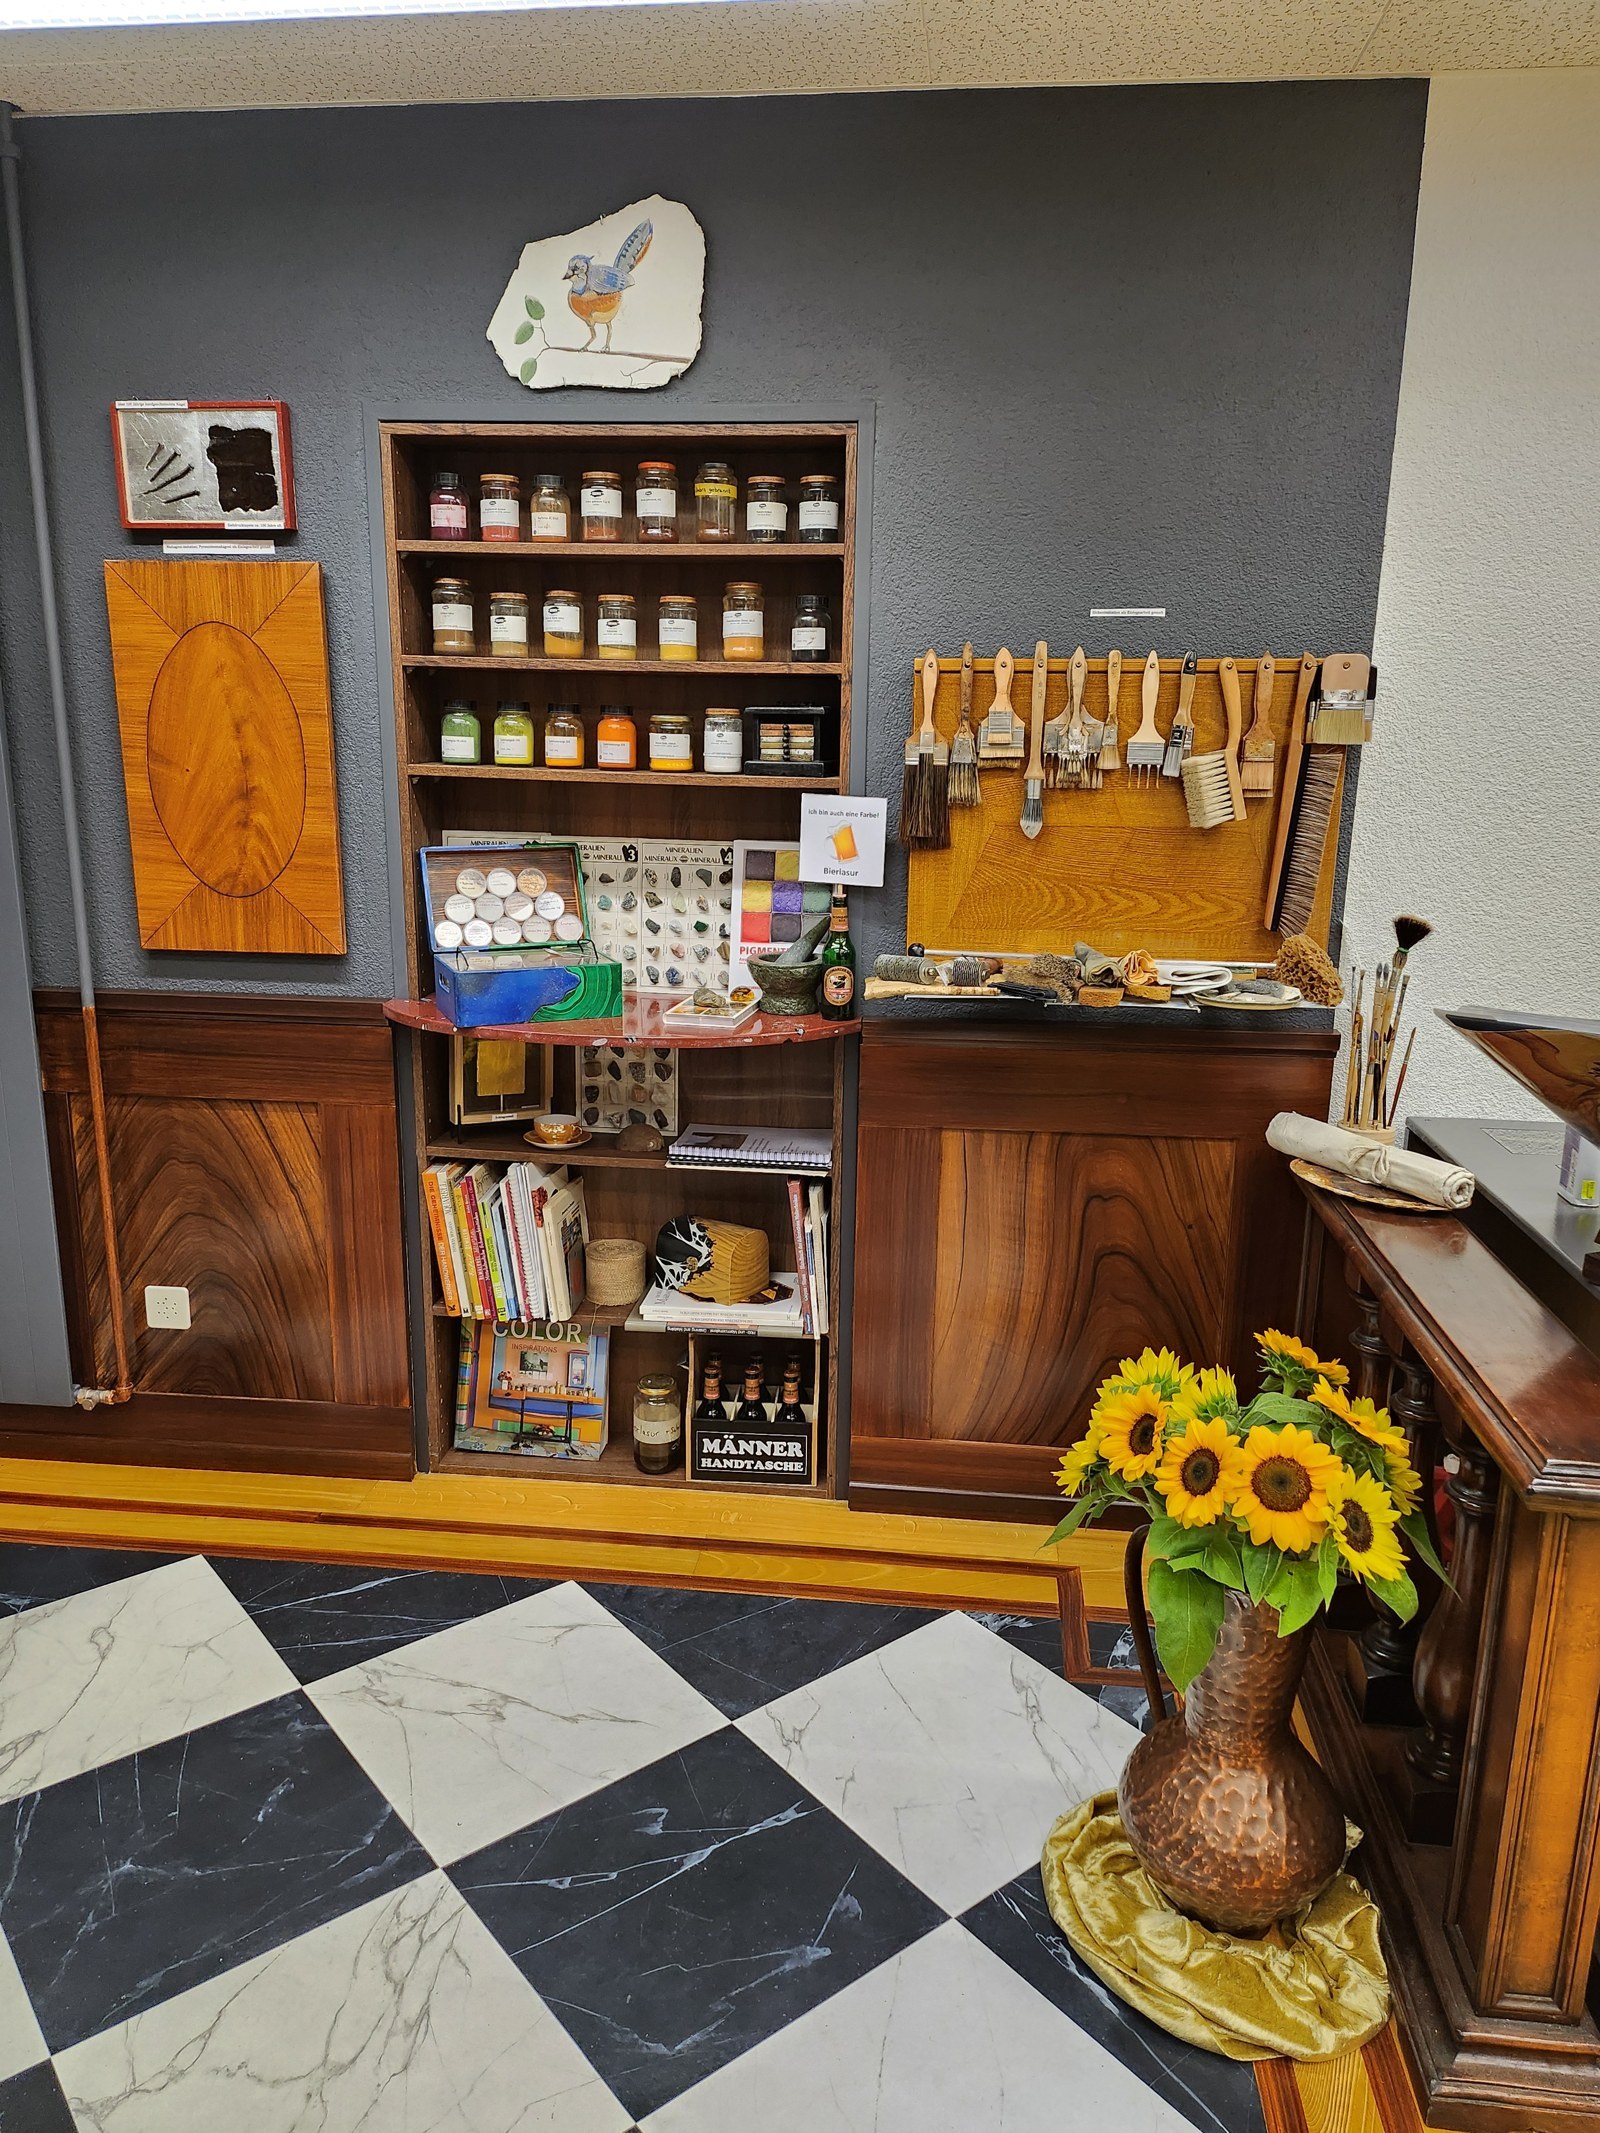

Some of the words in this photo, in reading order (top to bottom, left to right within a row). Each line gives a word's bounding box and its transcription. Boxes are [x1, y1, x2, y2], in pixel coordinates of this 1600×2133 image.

[628, 849, 636, 861] 3
[644, 854, 678, 862] MINÉRAUX
[724, 852, 733, 864] 4
[824, 868, 859, 877] Bierlasur
[740, 946, 788, 955] PIGMENT
[430, 1194, 443, 1240] GEHEIMNISSE
[438, 1242, 446, 1256] DER
[439, 1256, 453, 1301] HANDWERKER
[492, 1320, 582, 1343] COLOR
[512, 1344, 558, 1353] INSPIRATIONS
[702, 1435, 804, 1457] MÄNNER
[701, 1458, 804, 1472] HANDTASCHE
